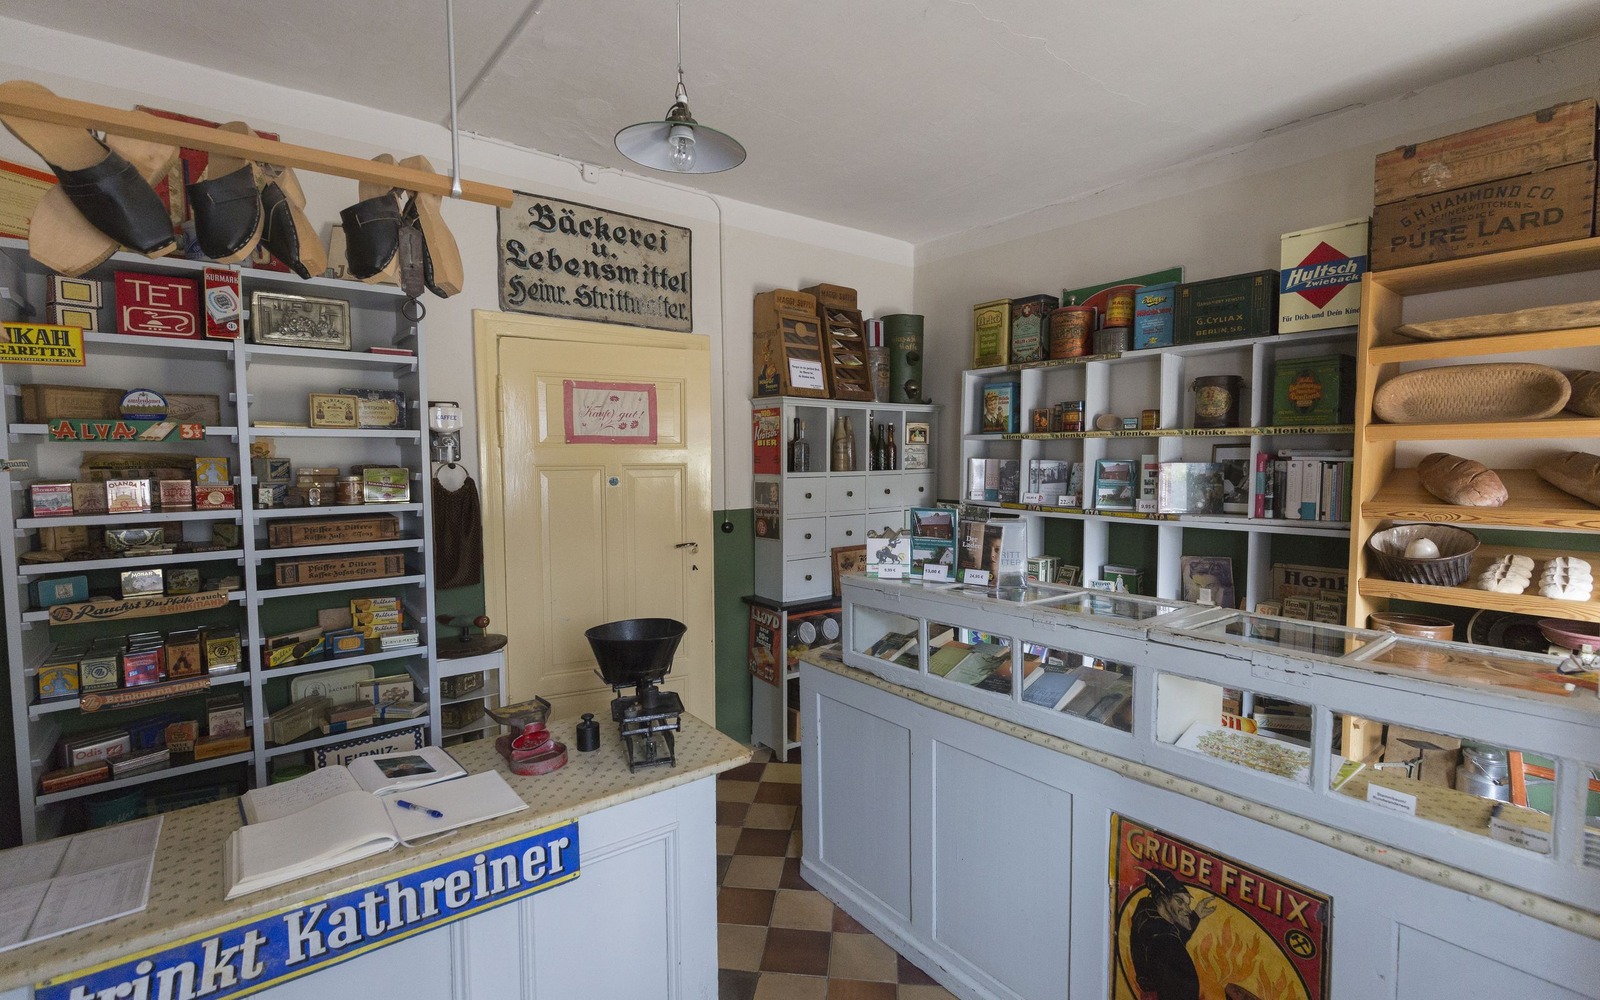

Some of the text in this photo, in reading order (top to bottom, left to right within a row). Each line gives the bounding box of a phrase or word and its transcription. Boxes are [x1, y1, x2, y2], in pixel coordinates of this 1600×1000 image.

[1527, 185, 1556, 201] CO.
[528, 203, 668, 253] Bäckerei
[1390, 207, 1564, 253] PURE LARD
[591, 242, 619, 260] u.
[505, 239, 689, 294] Lebensmittel
[1285, 259, 1358, 290] Hultsch
[1305, 273, 1359, 288] Zwieback
[124, 279, 192, 307] TET
[508, 274, 690, 321] Heinr. Strittmtter.
[1295, 313, 1309, 321] Dich
[1327, 309, 1343, 317] Dein
[50, 420, 137, 440] ALVA
[1273, 427, 1316, 435] Henko
[73, 600, 141, 620] Rauchst
[142, 599, 162, 609] Du
[751, 606, 780, 629] LLOYD
[106, 686, 172, 703] Brinkmann
[1126, 828, 1313, 931] GRUBE FELIX
[284, 837, 570, 966] Kathreiner
